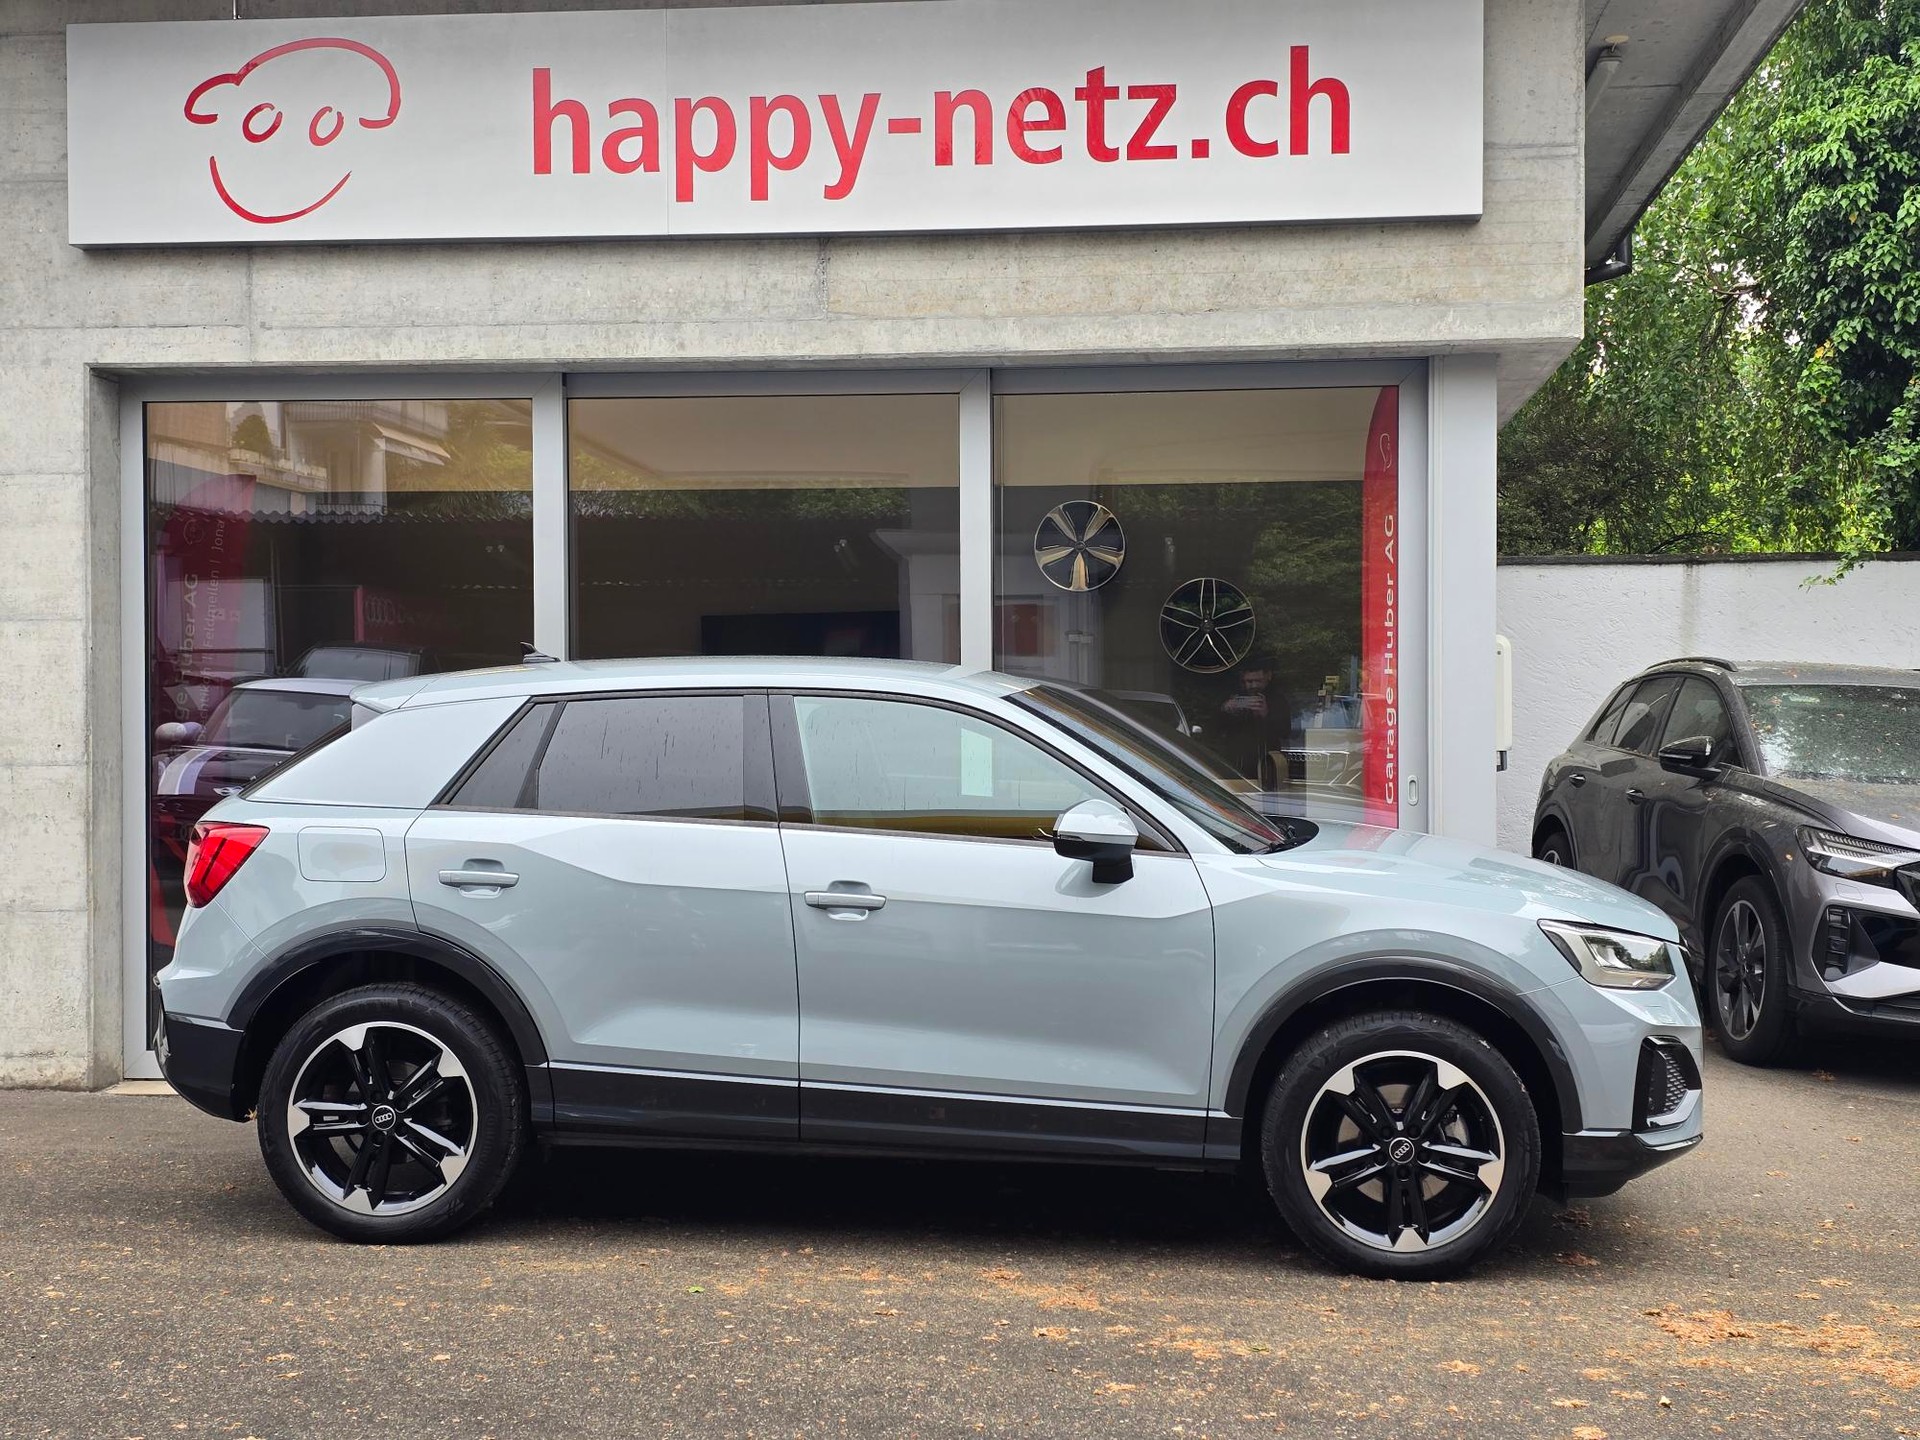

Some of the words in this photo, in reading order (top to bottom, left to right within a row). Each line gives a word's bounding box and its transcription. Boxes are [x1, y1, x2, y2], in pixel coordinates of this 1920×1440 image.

[531, 45, 1351, 203] happy-netz.ch
[1384, 514, 1394, 563] AG
[183, 573, 199, 607] AG
[1384, 573, 1394, 675] Huber
[1385, 687, 1397, 805] Garage
